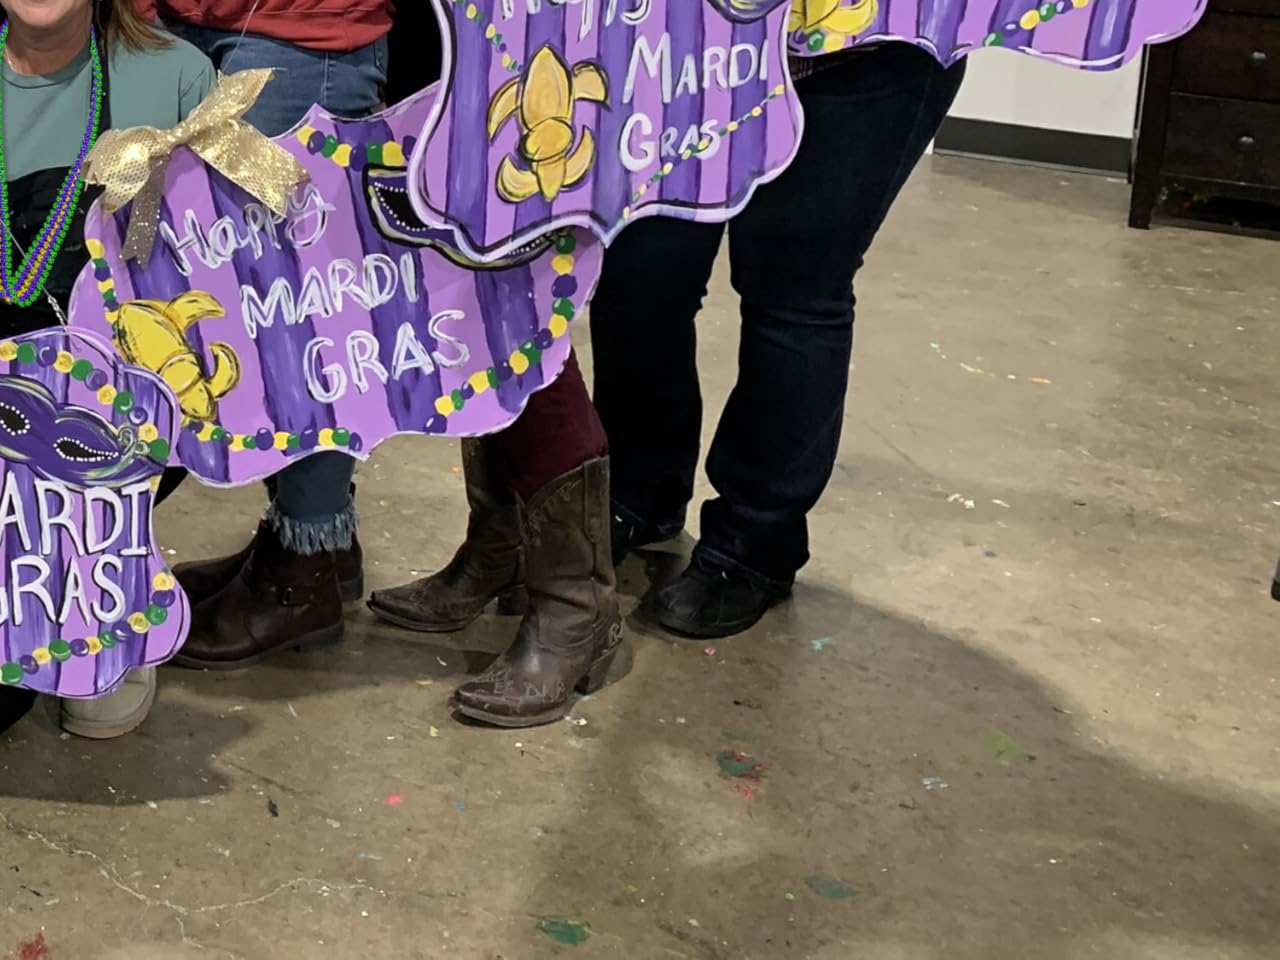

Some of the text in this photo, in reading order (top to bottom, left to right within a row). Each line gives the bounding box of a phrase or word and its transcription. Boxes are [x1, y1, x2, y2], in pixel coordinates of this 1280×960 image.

[160, 183, 336, 276] Happy
[240, 251, 419, 338] MARDI
[304, 309, 470, 403] GRAS
